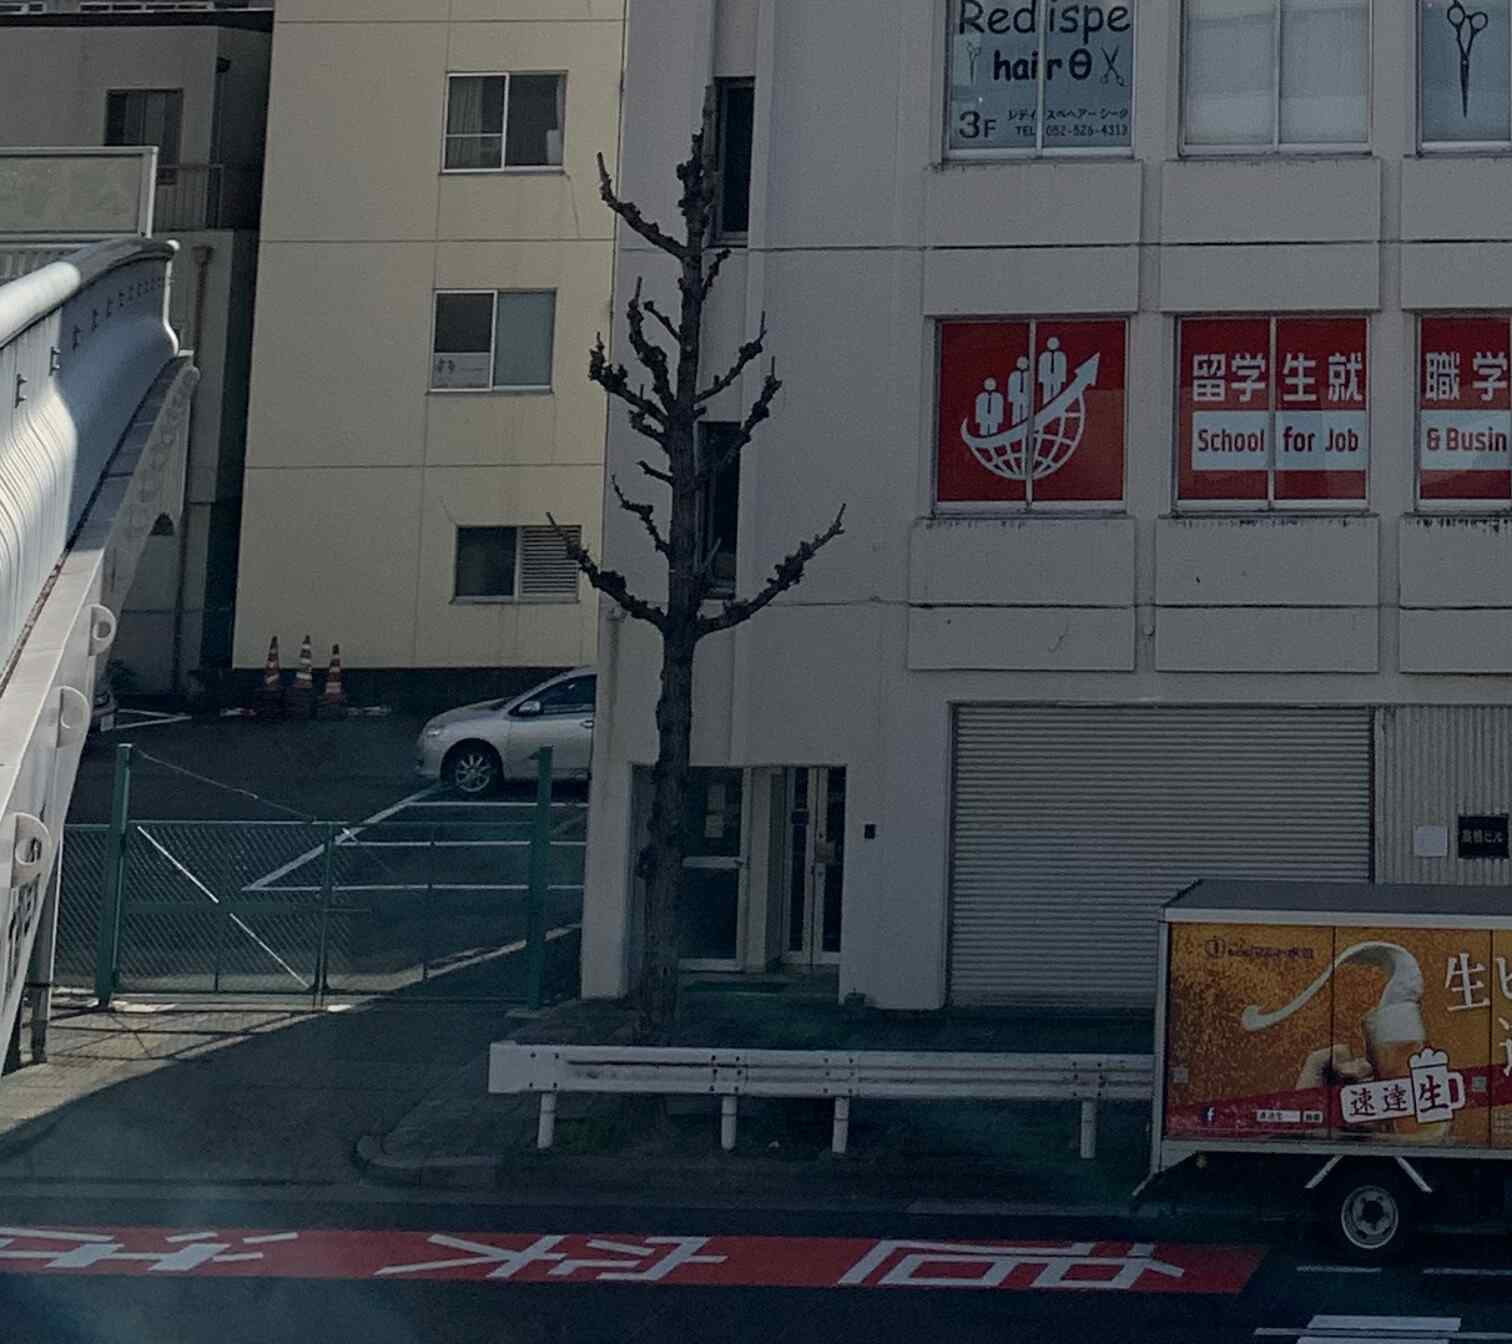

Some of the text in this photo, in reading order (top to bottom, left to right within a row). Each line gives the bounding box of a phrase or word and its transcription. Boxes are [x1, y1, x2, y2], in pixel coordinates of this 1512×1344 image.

[993, 49, 1062, 81] hair
[958, 110, 996, 138] 3F
[1016, 125, 1036, 137] TEL
[1198, 427, 1265, 452] School
[1283, 427, 1316, 452] for
[1324, 427, 1359, 452] Job
[1427, 428, 1440, 451] &
[1348, 1073, 1450, 1117] 速達生
